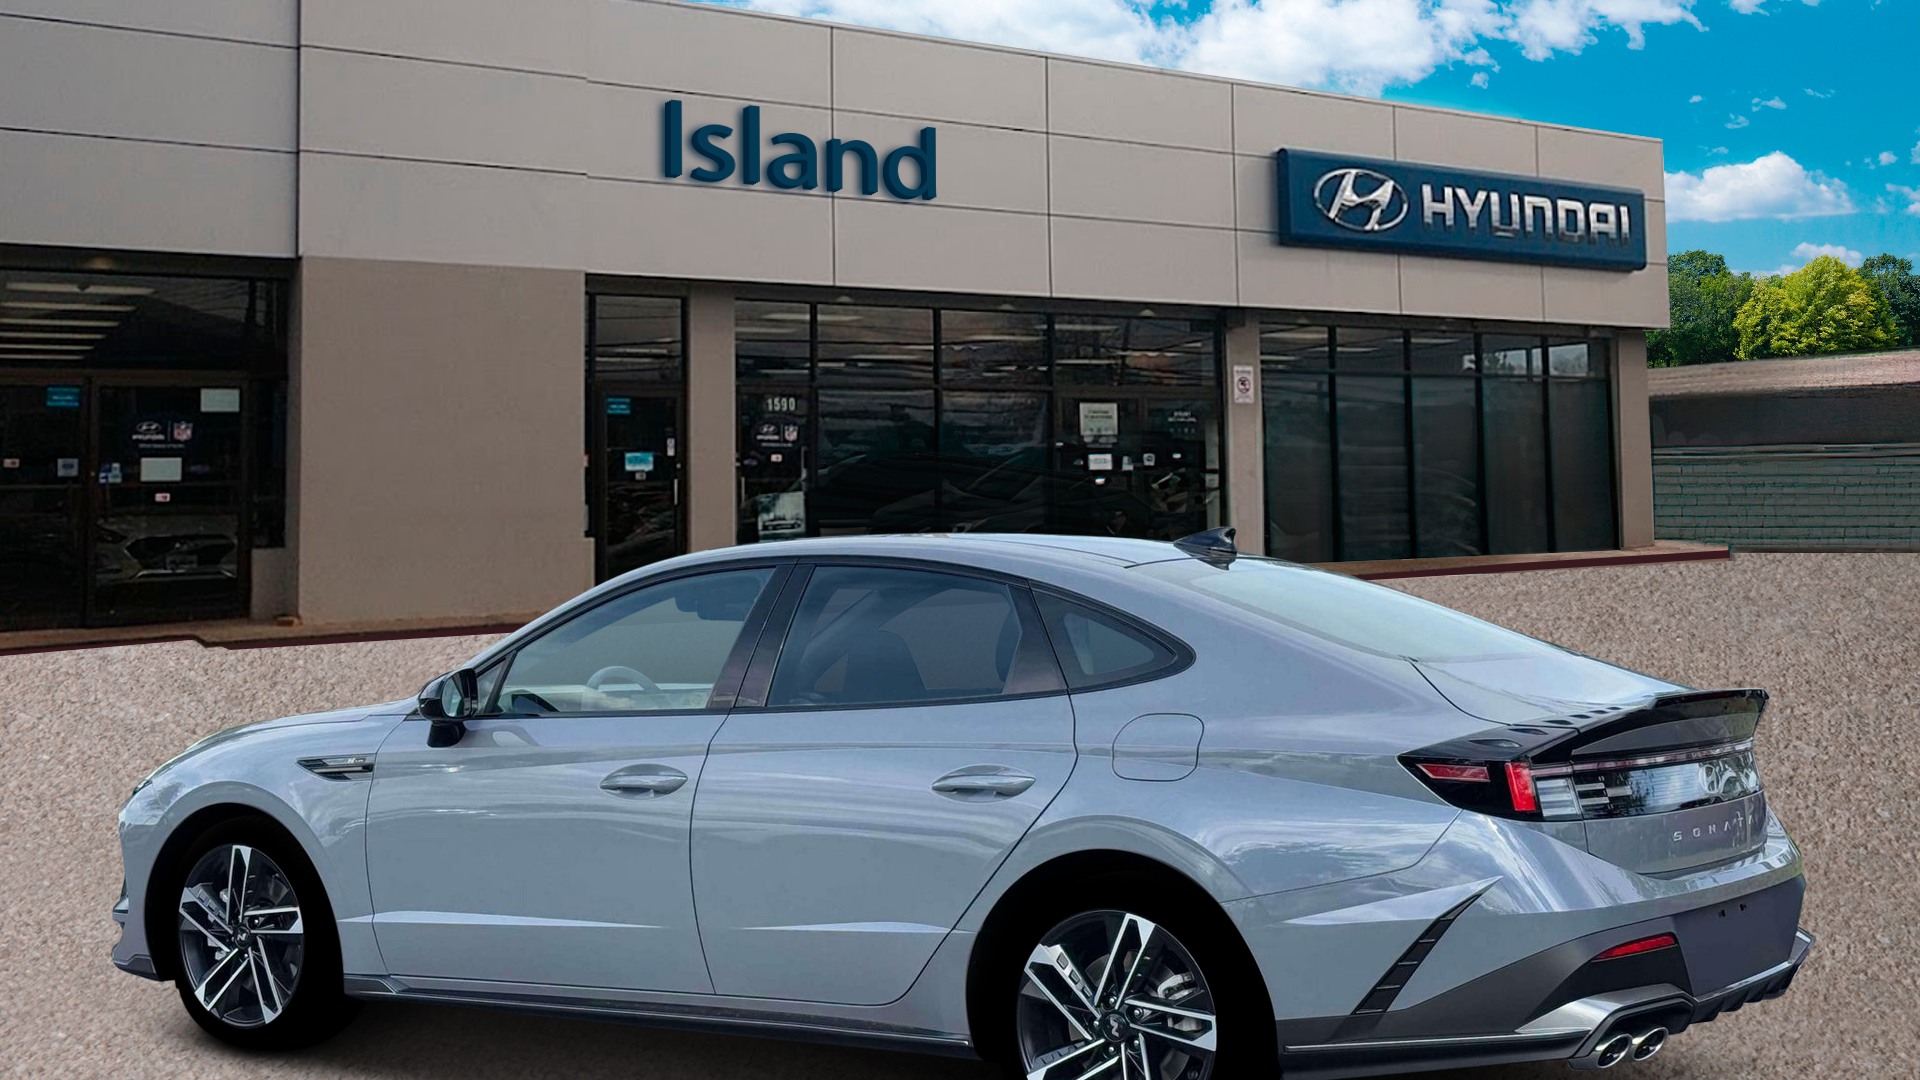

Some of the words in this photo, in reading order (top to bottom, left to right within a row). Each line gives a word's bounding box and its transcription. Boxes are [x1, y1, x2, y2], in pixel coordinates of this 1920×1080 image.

[664, 99, 937, 200] Island
[1421, 184, 1631, 244] HYUNDAI
[766, 397, 796, 411] 1590
